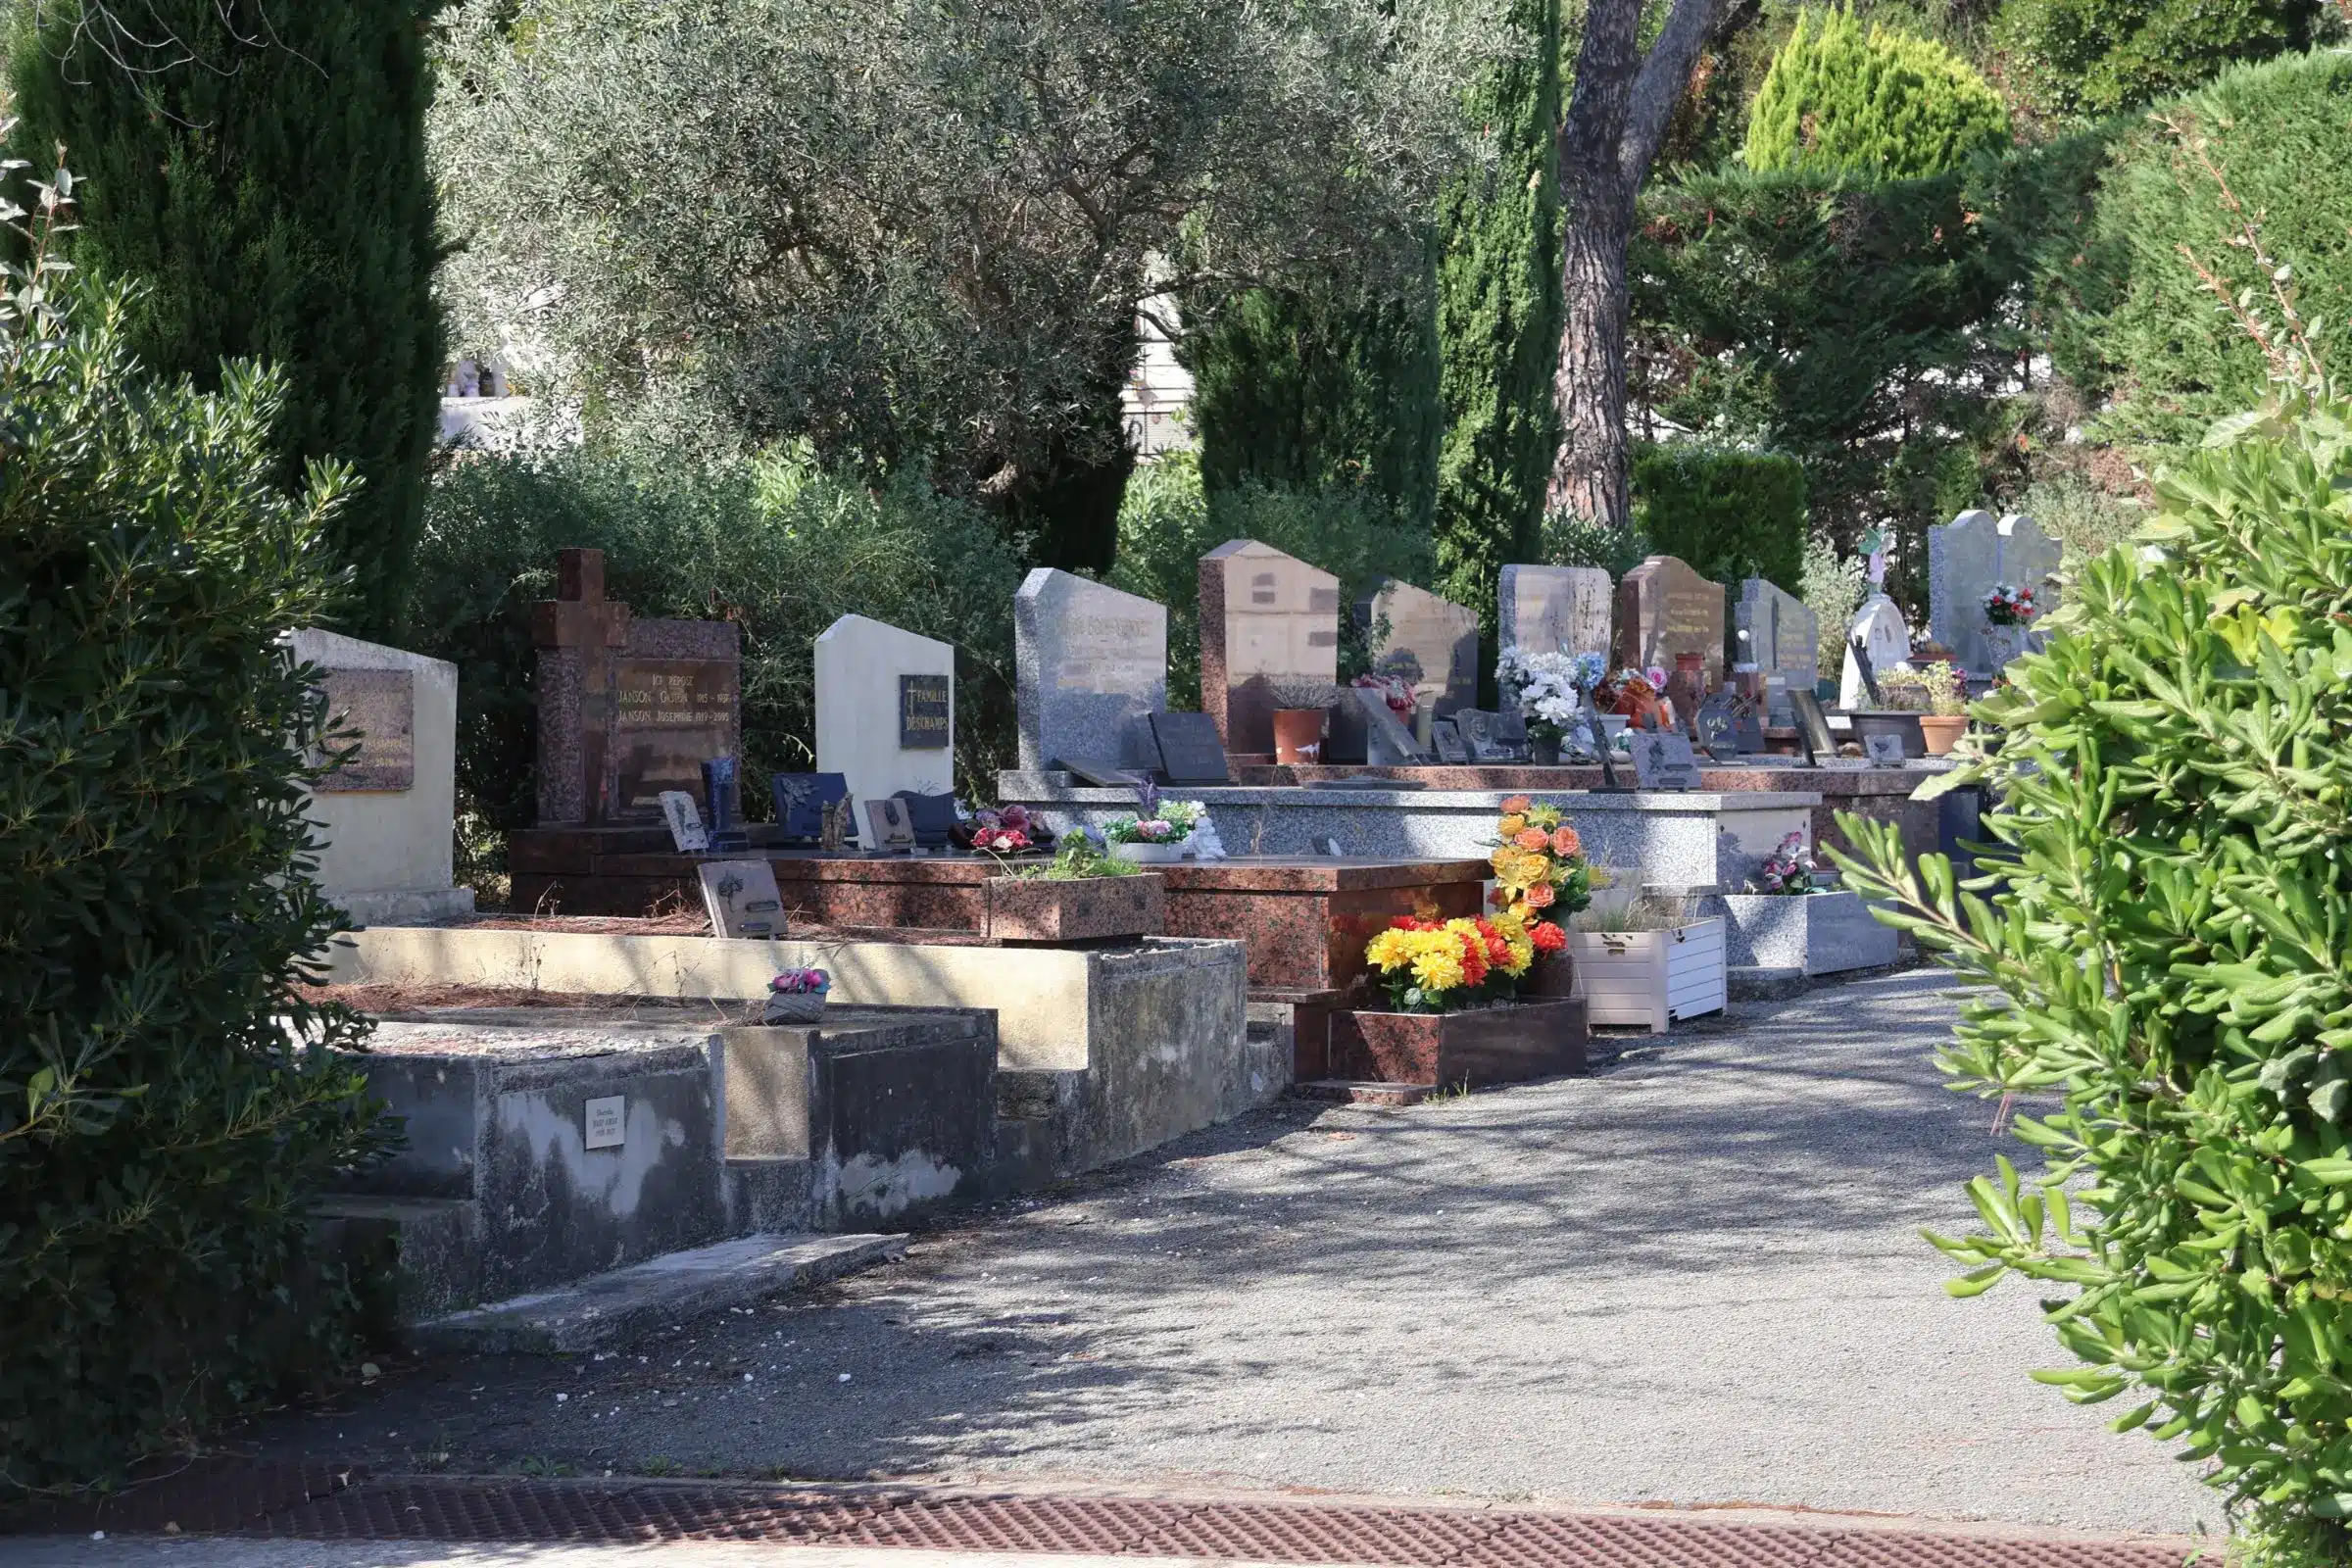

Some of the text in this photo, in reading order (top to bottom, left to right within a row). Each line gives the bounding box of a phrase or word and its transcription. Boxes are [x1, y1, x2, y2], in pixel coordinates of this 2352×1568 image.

[618, 690, 651, 703] JANSON
[917, 689, 948, 702] FAMILLE
[618, 710, 651, 722] JANSON
[906, 716, 949, 730] DESCHAMPS
